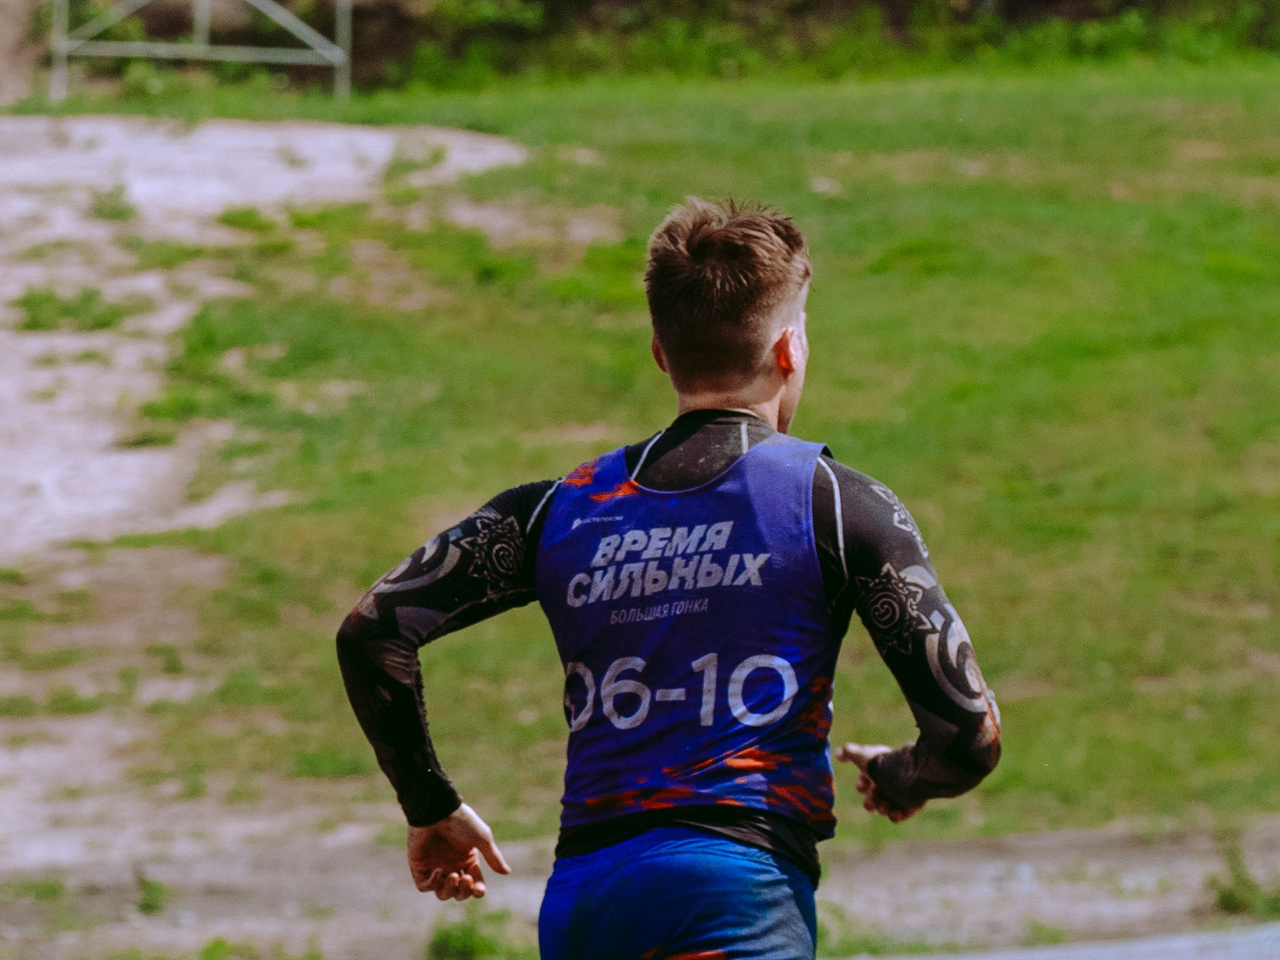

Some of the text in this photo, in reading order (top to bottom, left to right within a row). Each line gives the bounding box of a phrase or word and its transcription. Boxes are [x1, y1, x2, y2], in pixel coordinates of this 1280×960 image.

[590, 520, 734, 568] ВРЕМЯ
[566, 552, 771, 608] СИЛЬНЫХ
[609, 598, 709, 625] БОЛЬШАЯ ГОНКА
[563, 652, 800, 733] 06-10
